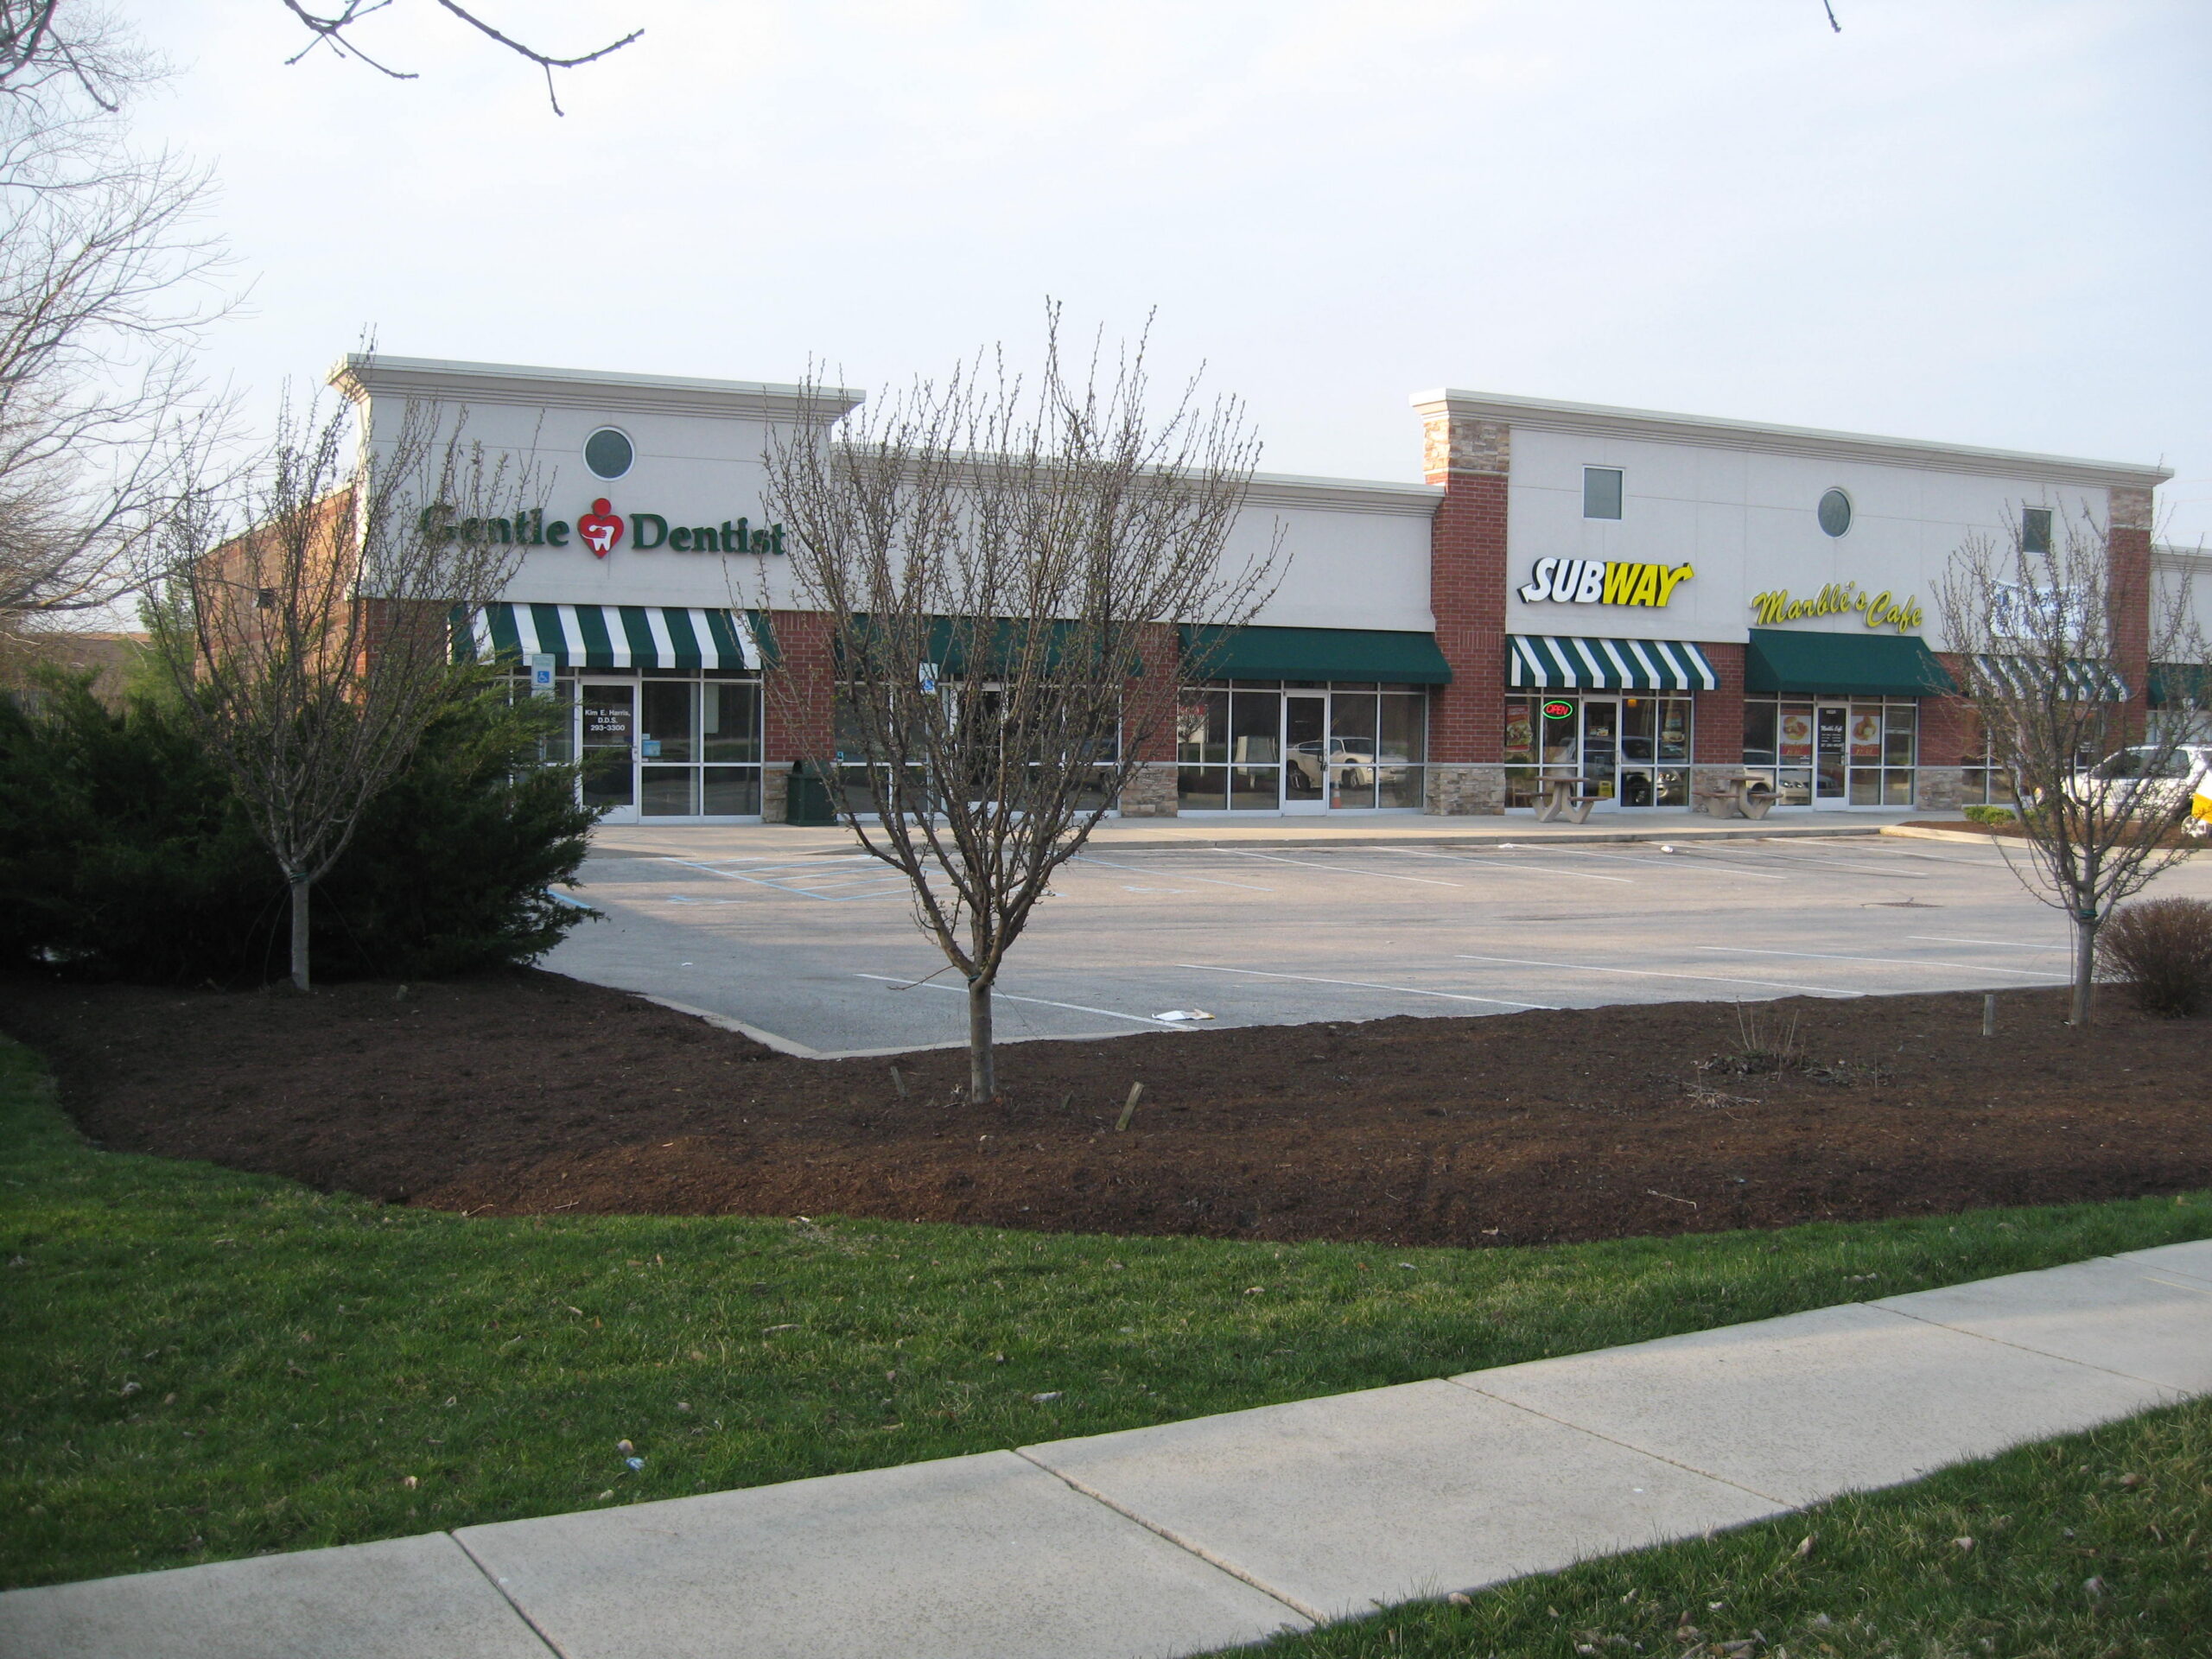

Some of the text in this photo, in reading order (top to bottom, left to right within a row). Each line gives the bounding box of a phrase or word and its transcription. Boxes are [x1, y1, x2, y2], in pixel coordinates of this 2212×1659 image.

[423, 504, 785, 556] Gentle Dentist
[1517, 557, 1694, 607] SUBWAY
[1750, 581, 1923, 632] Marble's Cafe
[1546, 703, 1569, 715] OPEN
